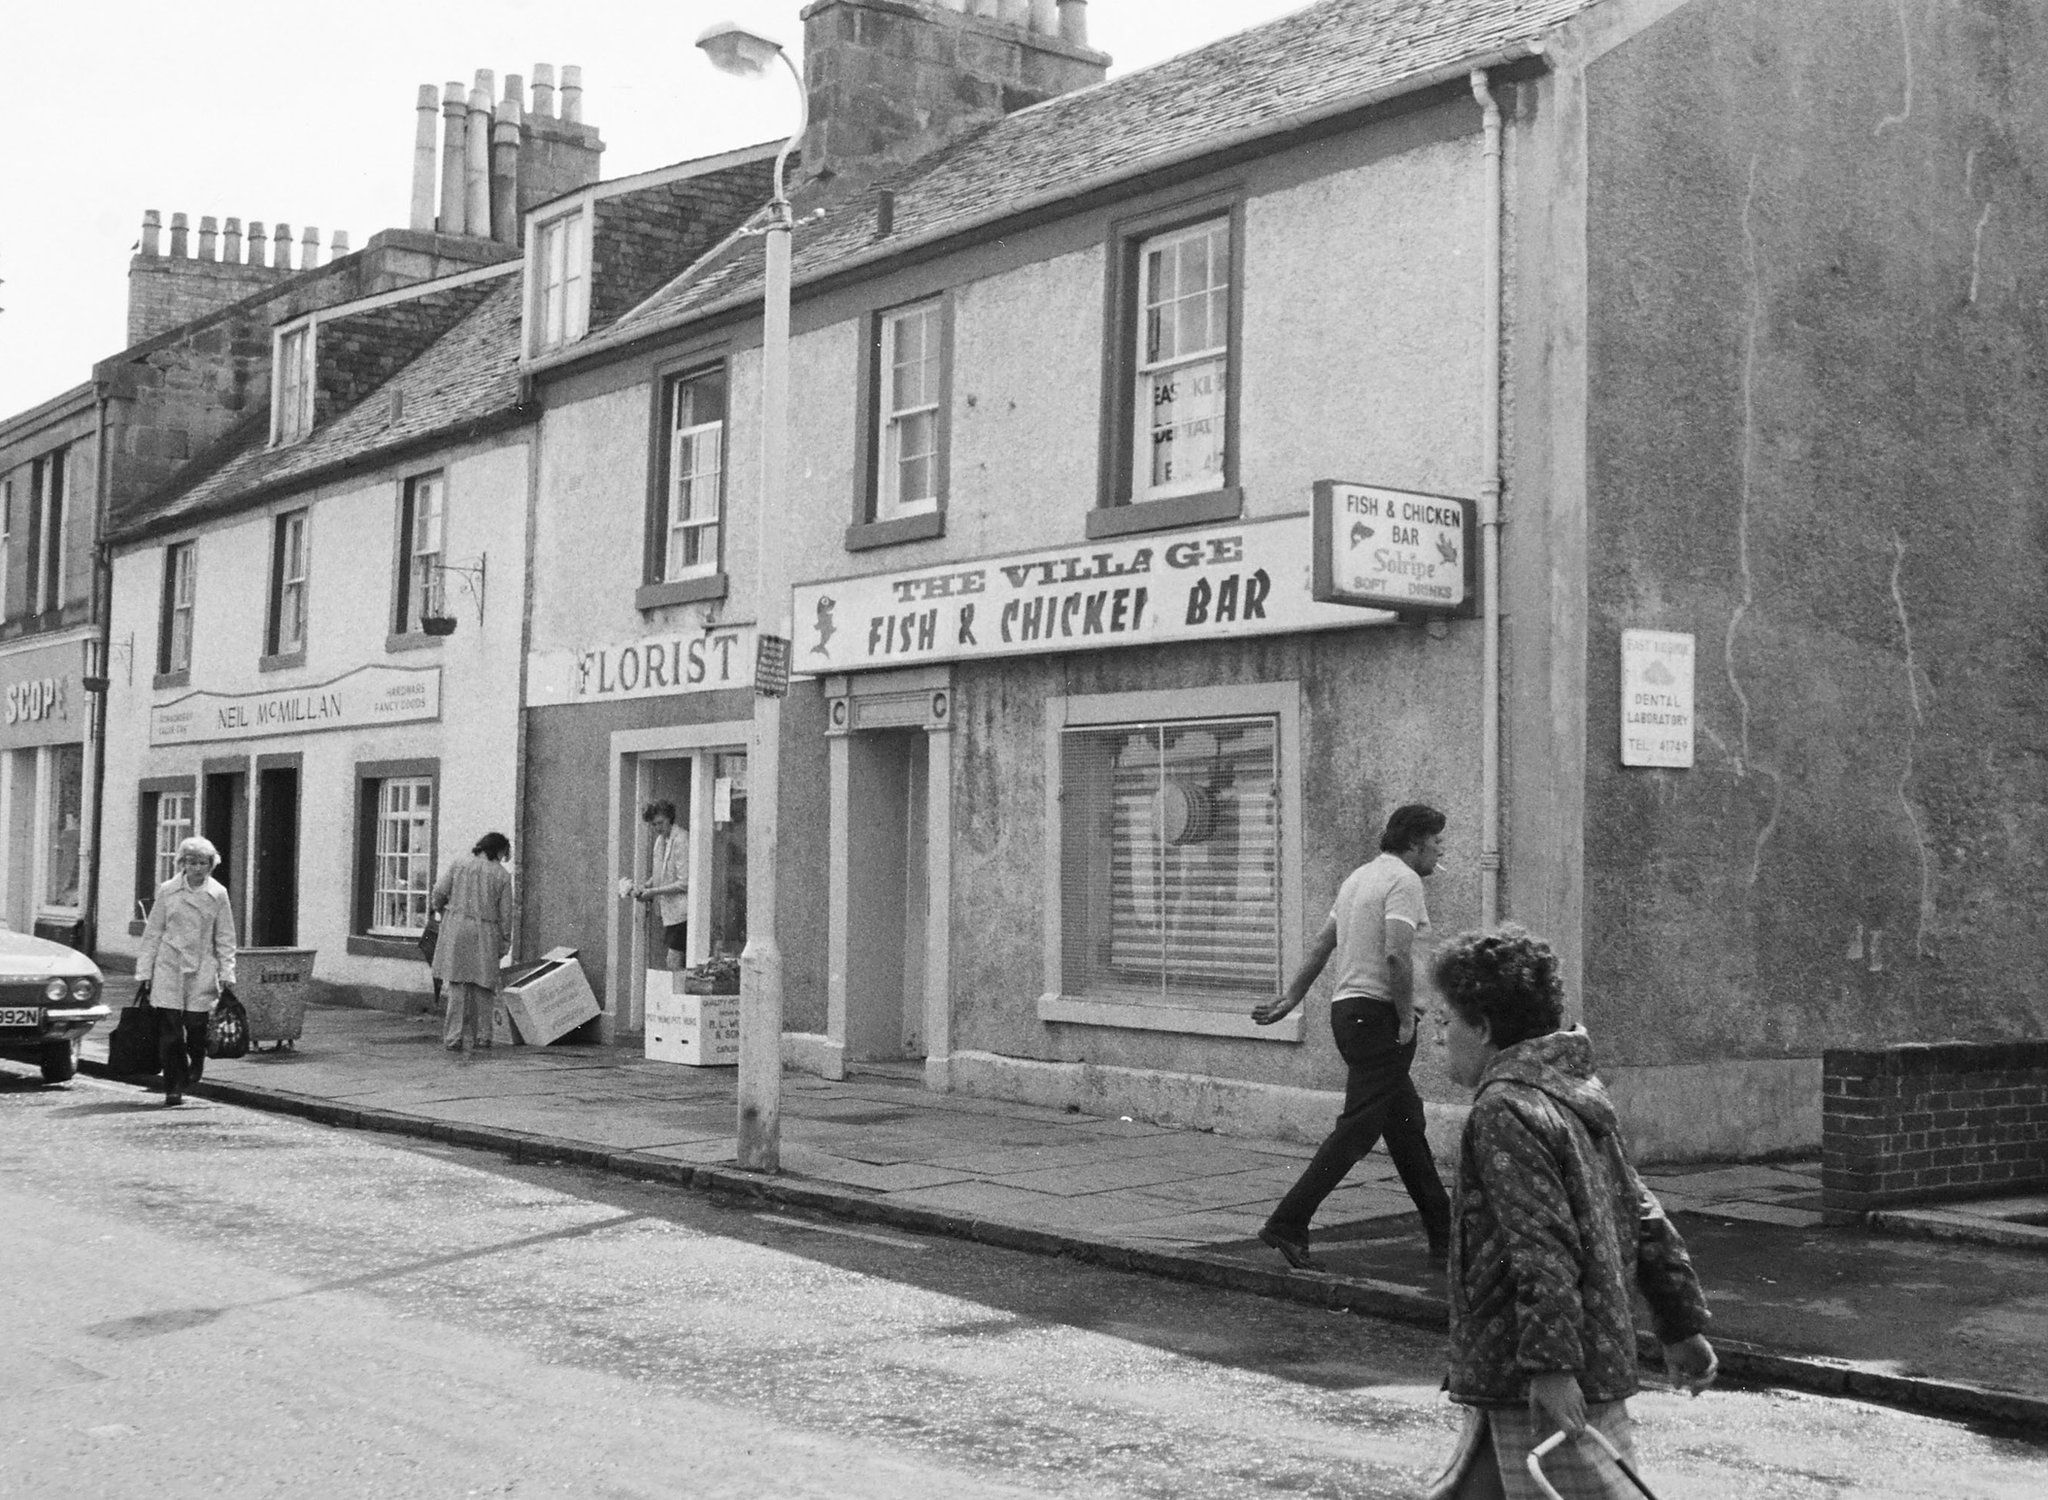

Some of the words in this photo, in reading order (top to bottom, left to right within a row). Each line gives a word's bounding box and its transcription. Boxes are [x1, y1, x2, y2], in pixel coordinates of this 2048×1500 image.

[1347, 495, 1378, 516] FISH
[1386, 500, 1395, 518] &
[1403, 503, 1461, 528] CHICKEN
[1392, 525, 1420, 546] BAR
[893, 571, 986, 603] THE
[1001, 536, 1244, 589] VILLAGE
[1353, 576, 1388, 592] SOFT
[1408, 582, 1453, 599] DRINKS
[868, 608, 937, 656] FISH
[958, 603, 977, 646] &
[1184, 568, 1271, 626] BAR
[578, 634, 738, 695] FLORIST
[386, 683, 425, 697] HARDWARE
[1635, 693, 1681, 707] DENTAL
[374, 701, 399, 713] FANCY
[401, 697, 426, 710] GOODS
[218, 706, 248, 729] NEIL
[1627, 712, 1688, 726] LABORATORY
[262, 973, 300, 983] LITTER
